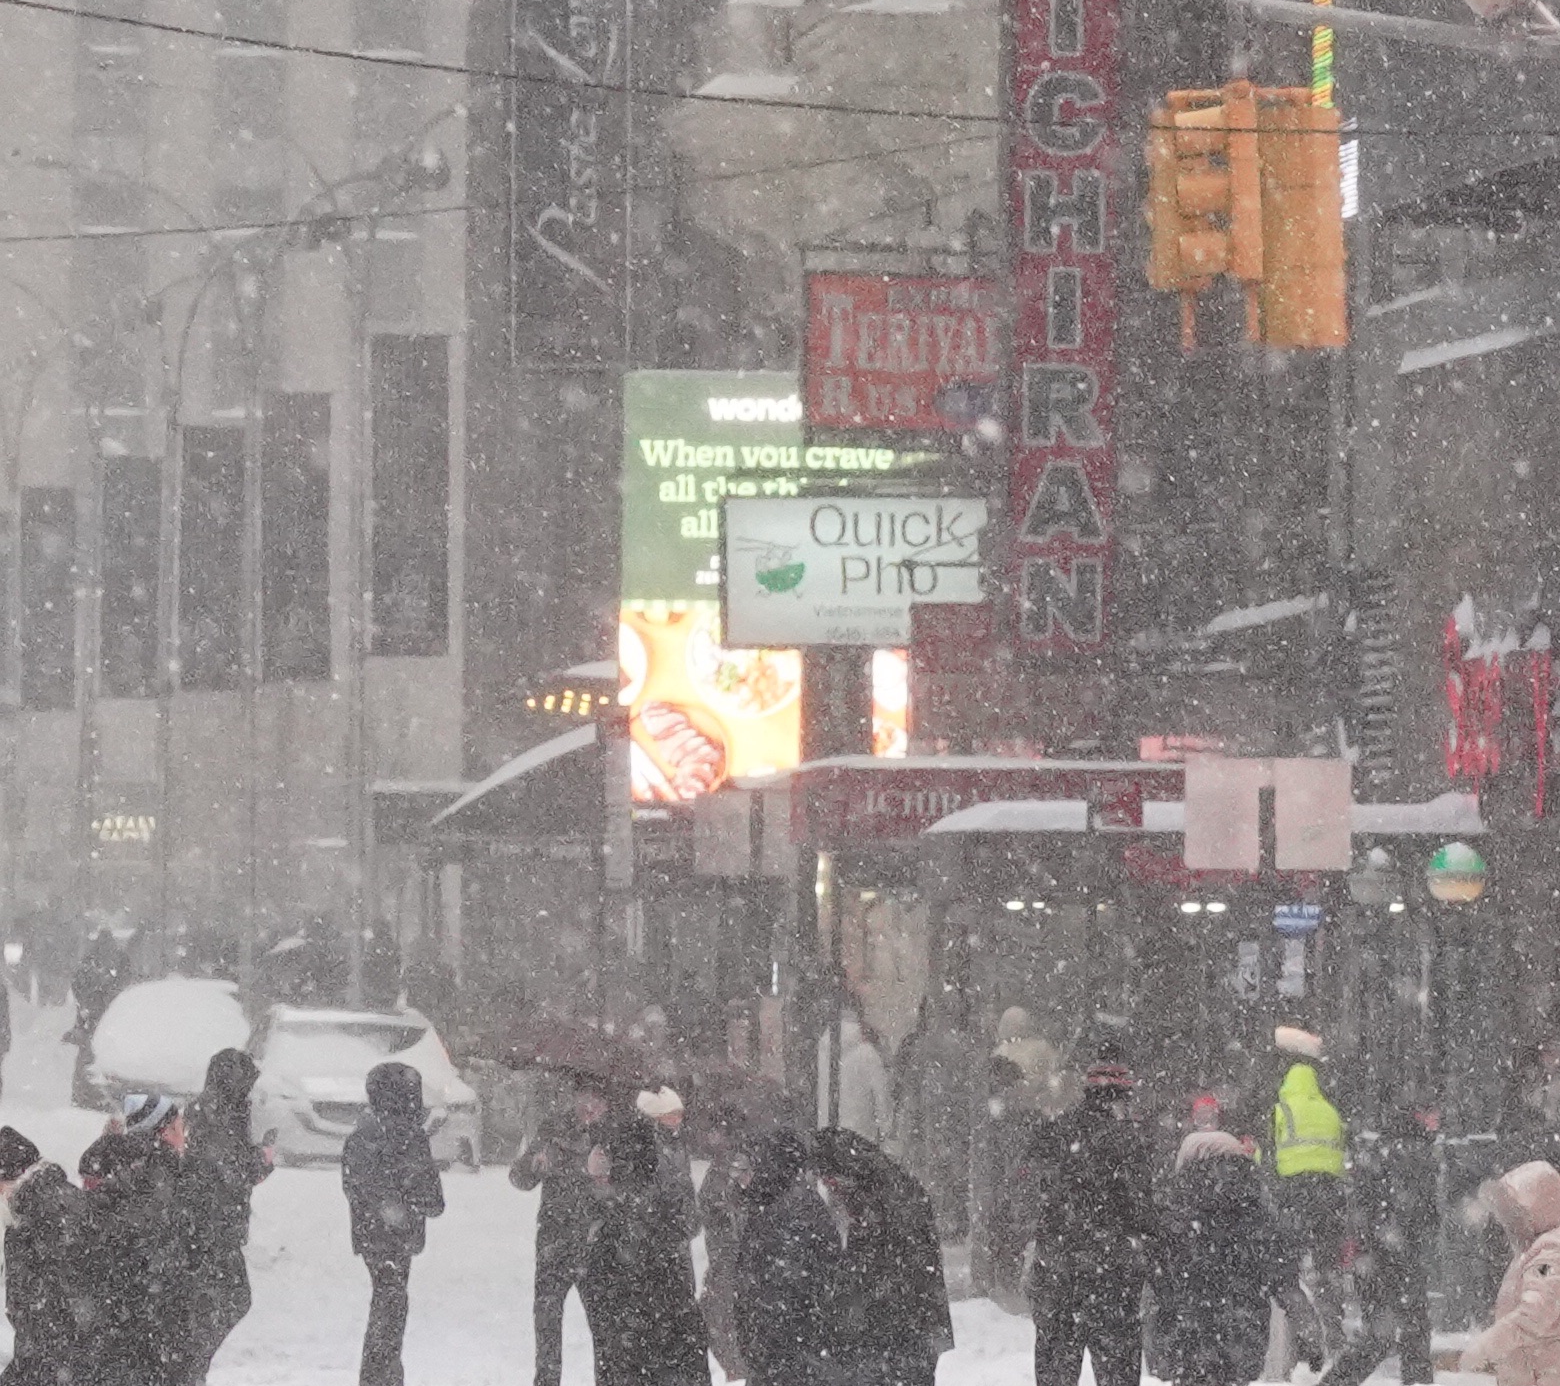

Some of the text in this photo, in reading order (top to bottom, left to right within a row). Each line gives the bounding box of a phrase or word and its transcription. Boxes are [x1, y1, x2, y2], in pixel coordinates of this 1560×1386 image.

[709, 392, 802, 422] wond
[638, 439, 894, 472] When you crave
[659, 474, 696, 503] all
[809, 503, 966, 549] Quick
[840, 555, 937, 596] Pho
